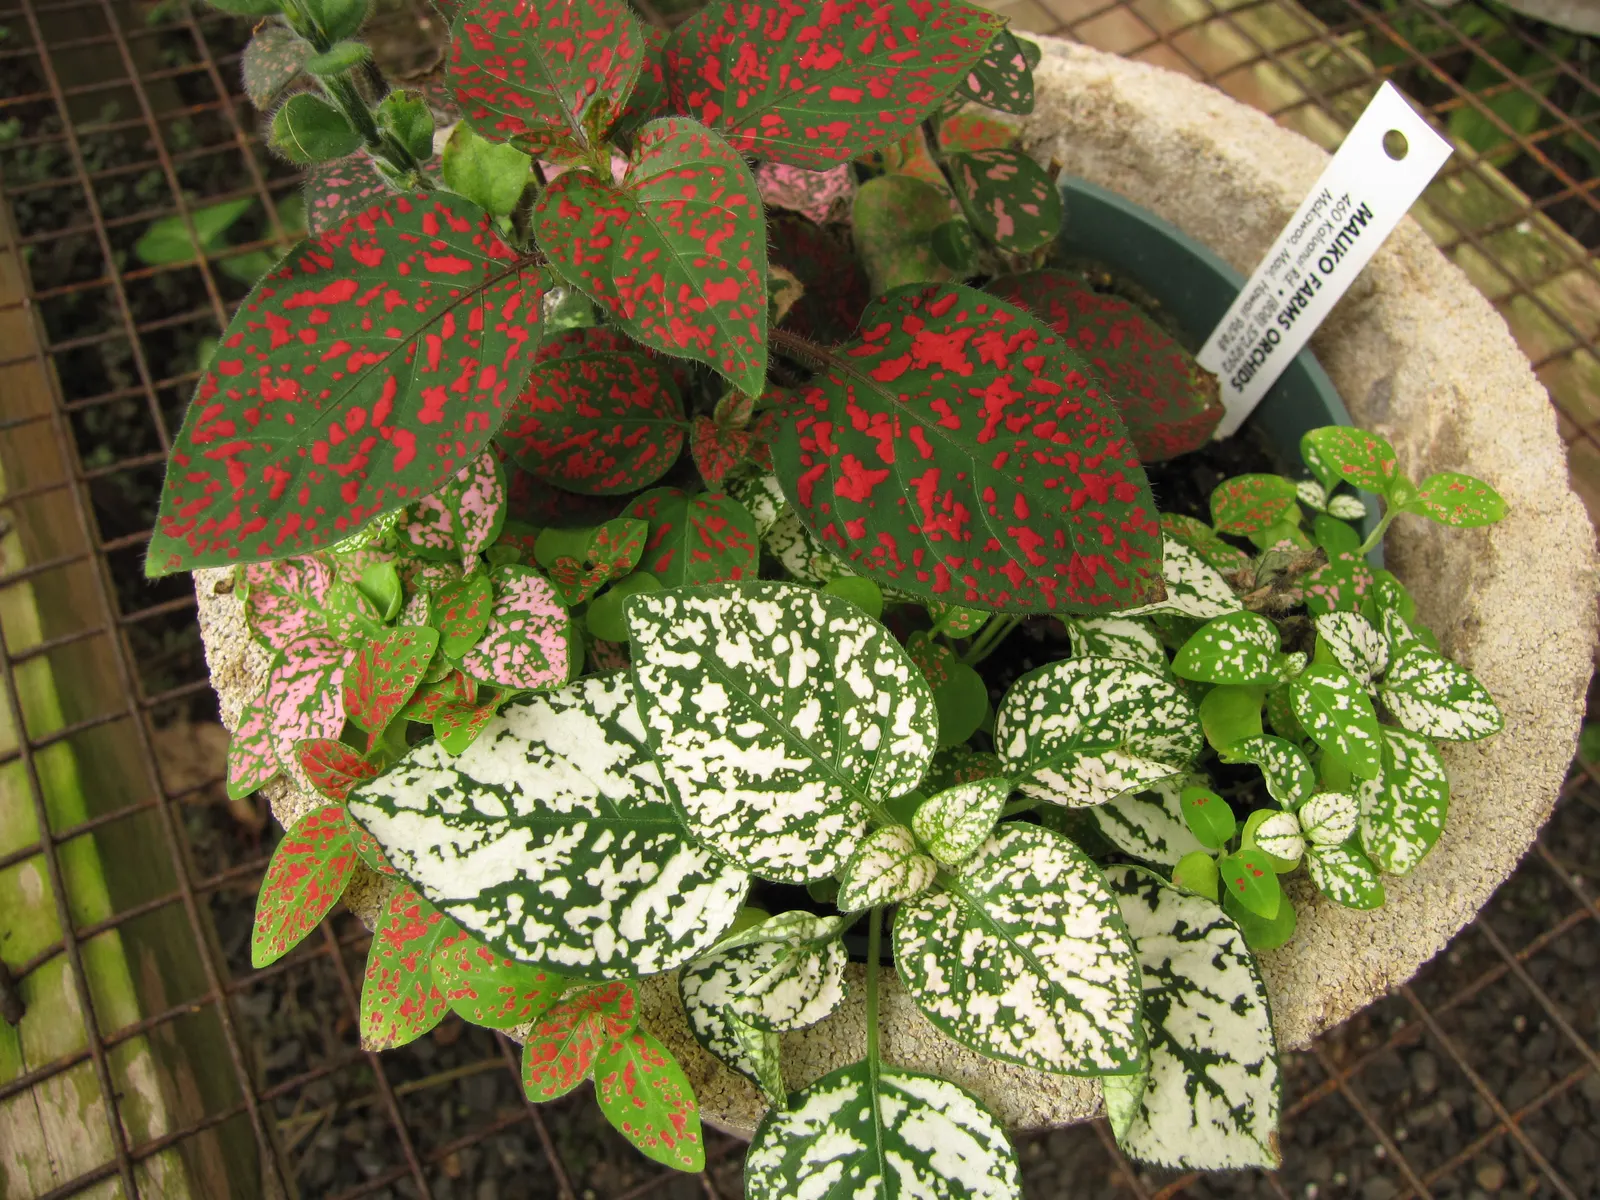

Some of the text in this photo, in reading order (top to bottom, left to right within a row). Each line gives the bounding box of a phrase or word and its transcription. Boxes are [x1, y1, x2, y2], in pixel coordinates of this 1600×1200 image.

[1331, 193, 1351, 221] 460
[1230, 202, 1373, 394] MALIKO FARMS ORCHIDS
